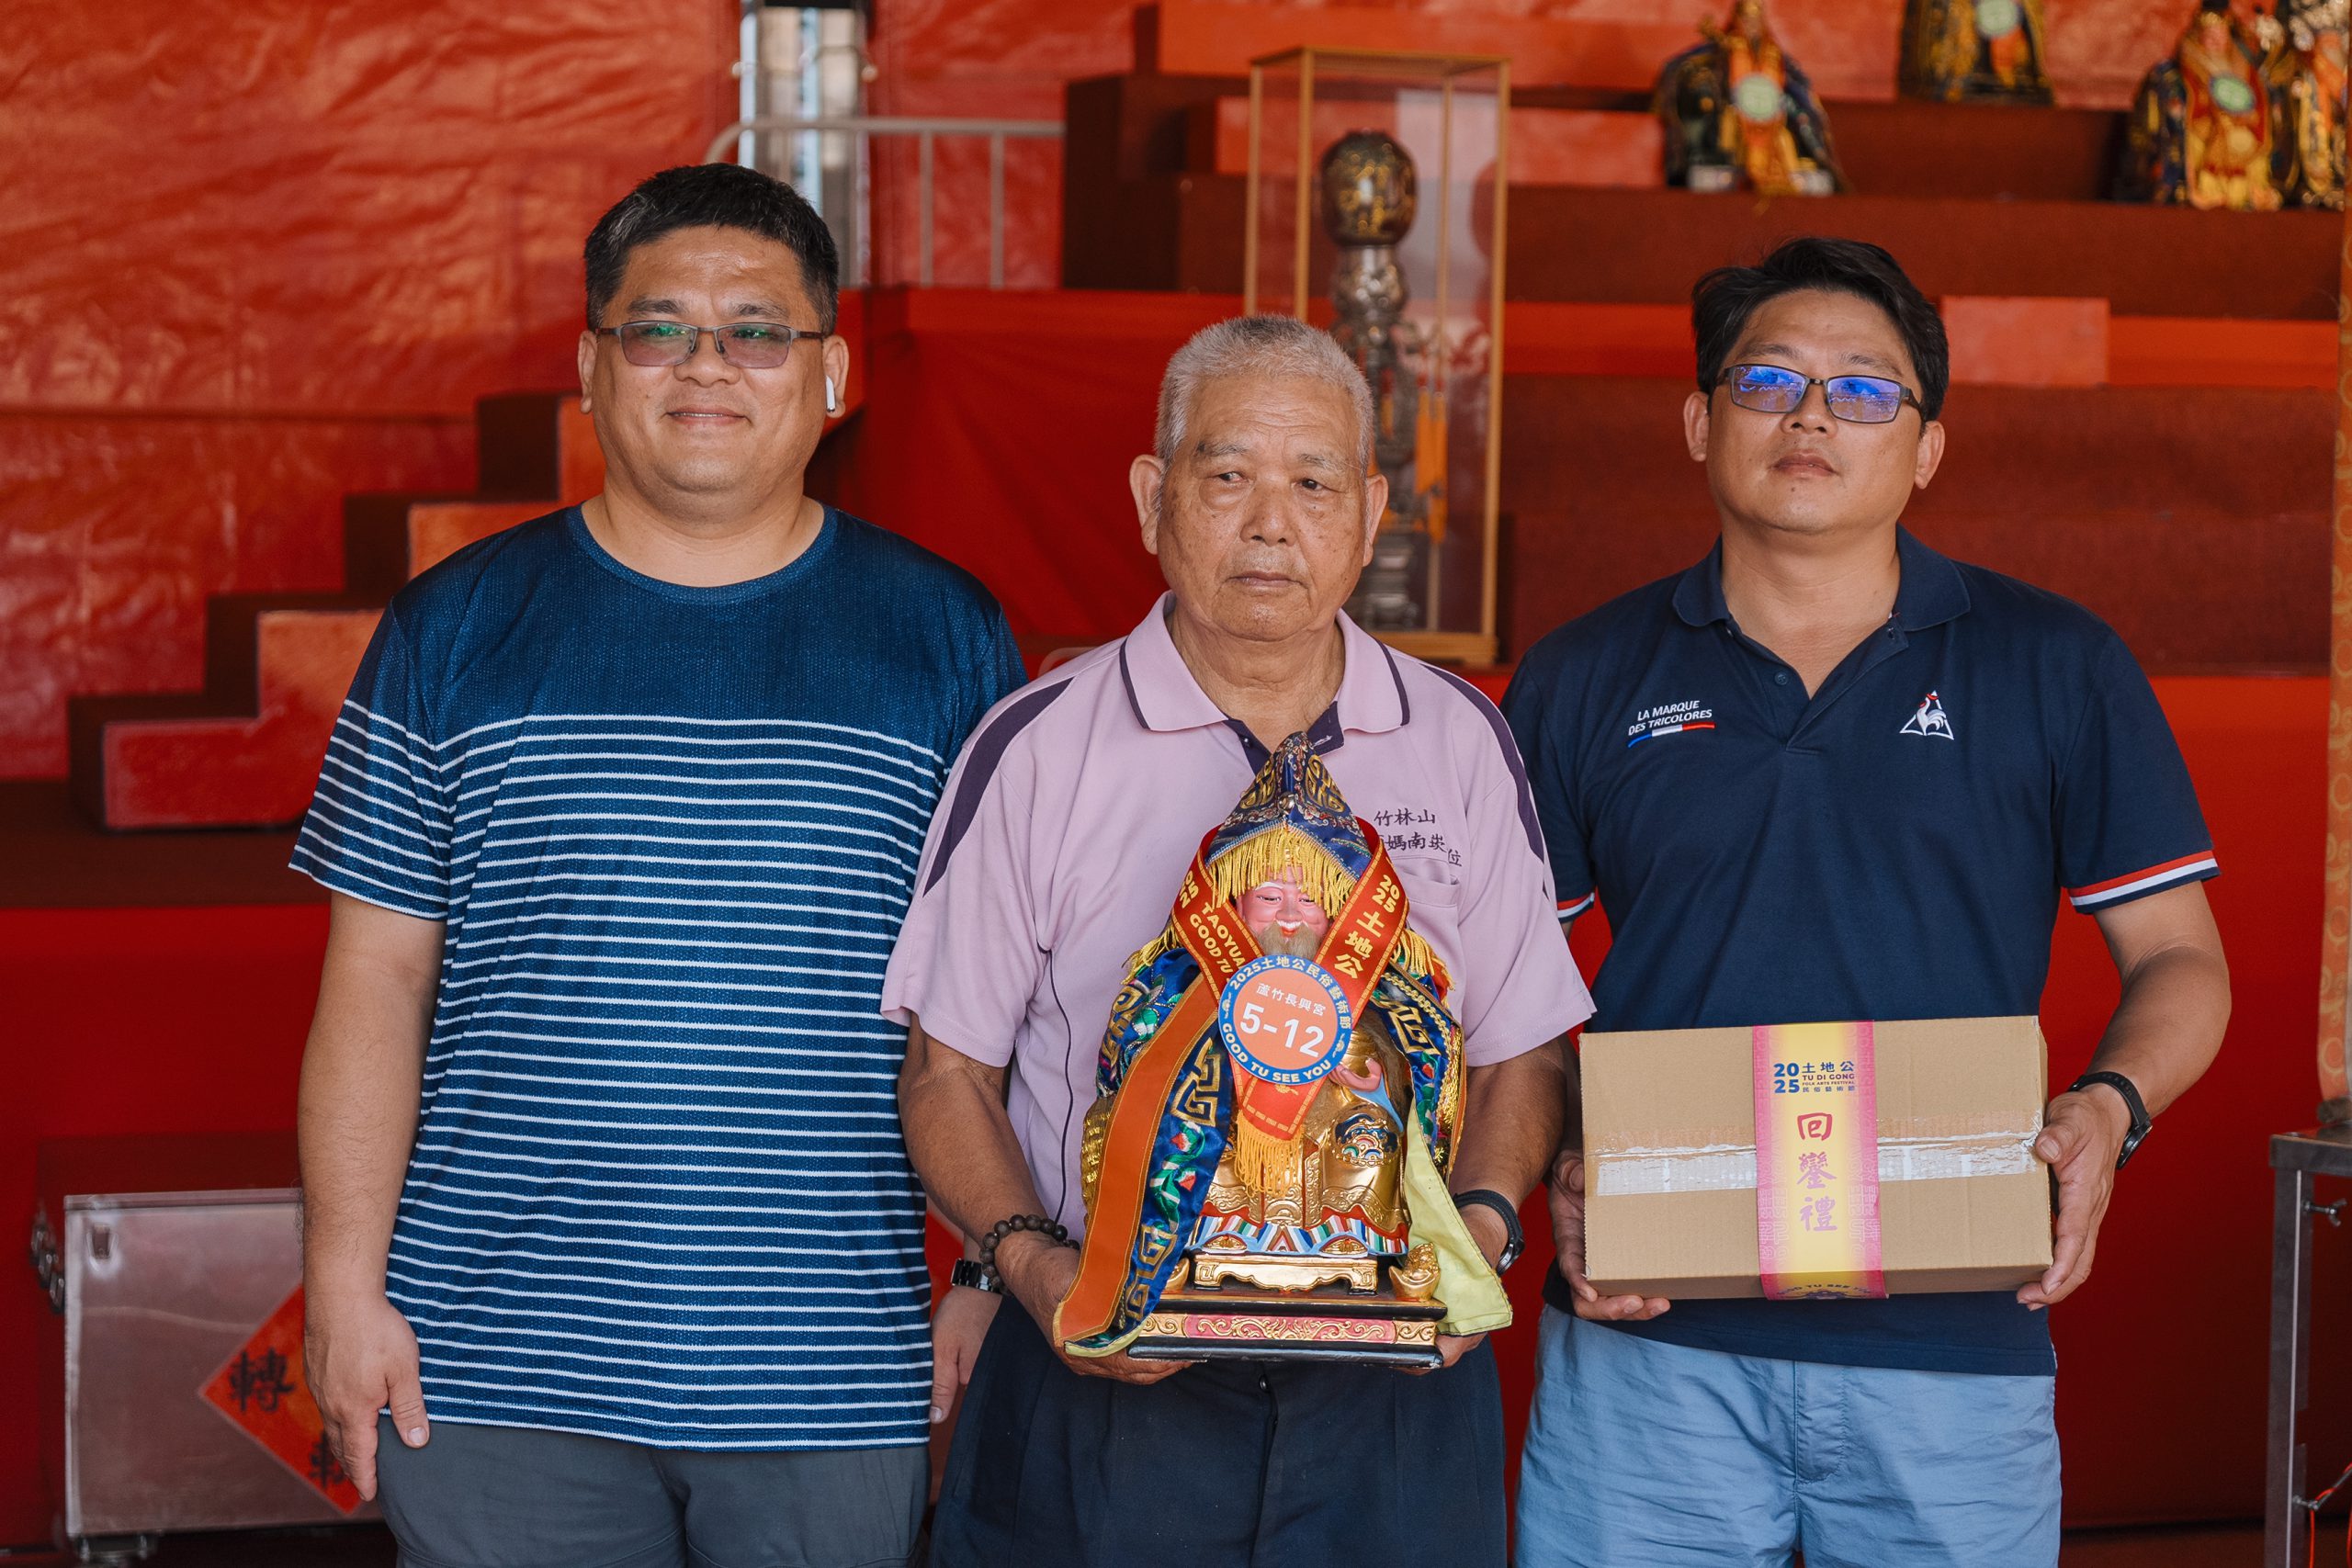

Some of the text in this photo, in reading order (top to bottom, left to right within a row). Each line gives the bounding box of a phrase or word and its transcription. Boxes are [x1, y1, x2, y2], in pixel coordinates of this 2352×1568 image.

[1628, 709, 1713, 736] DES TRICOLORES
[1637, 700, 1700, 721] LA MARQUE
[1374, 807, 1436, 827] 竹林山
[1378, 831, 1462, 866] 媽南崁位
[1372, 887, 1396, 913] 25
[1379, 874, 1400, 900] 20
[1190, 914, 1234, 974] GOOD TU
[1202, 902, 1246, 970] TAOYUA
[1334, 911, 1385, 979] 土地公
[1256, 983, 1326, 1016] 蘆竹長興宮
[1240, 1002, 1324, 1058] 5-12
[1222, 1022, 1331, 1083] GOOD TU SEE YOU
[1773, 1063, 1800, 1077] 20
[1802, 1061, 1854, 1073] 土地公
[1773, 1079, 1801, 1093] 25
